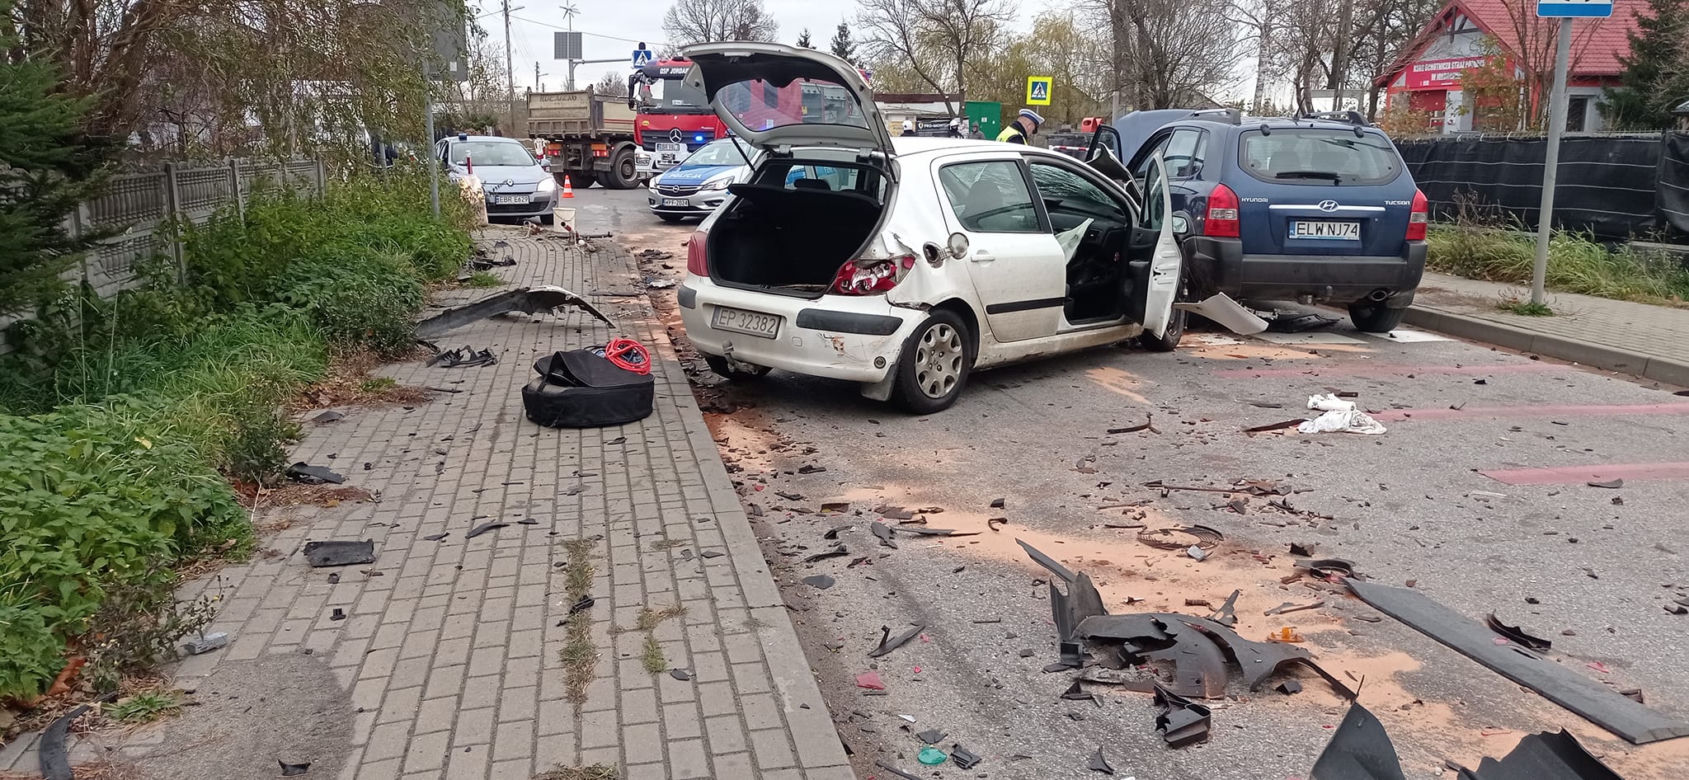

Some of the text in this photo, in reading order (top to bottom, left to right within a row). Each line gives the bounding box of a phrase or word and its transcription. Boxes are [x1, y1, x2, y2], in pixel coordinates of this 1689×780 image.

[500, 195, 512, 203] EBR
[1297, 222, 1358, 236] ELW NJ74
[719, 309, 776, 333] EP 32382
